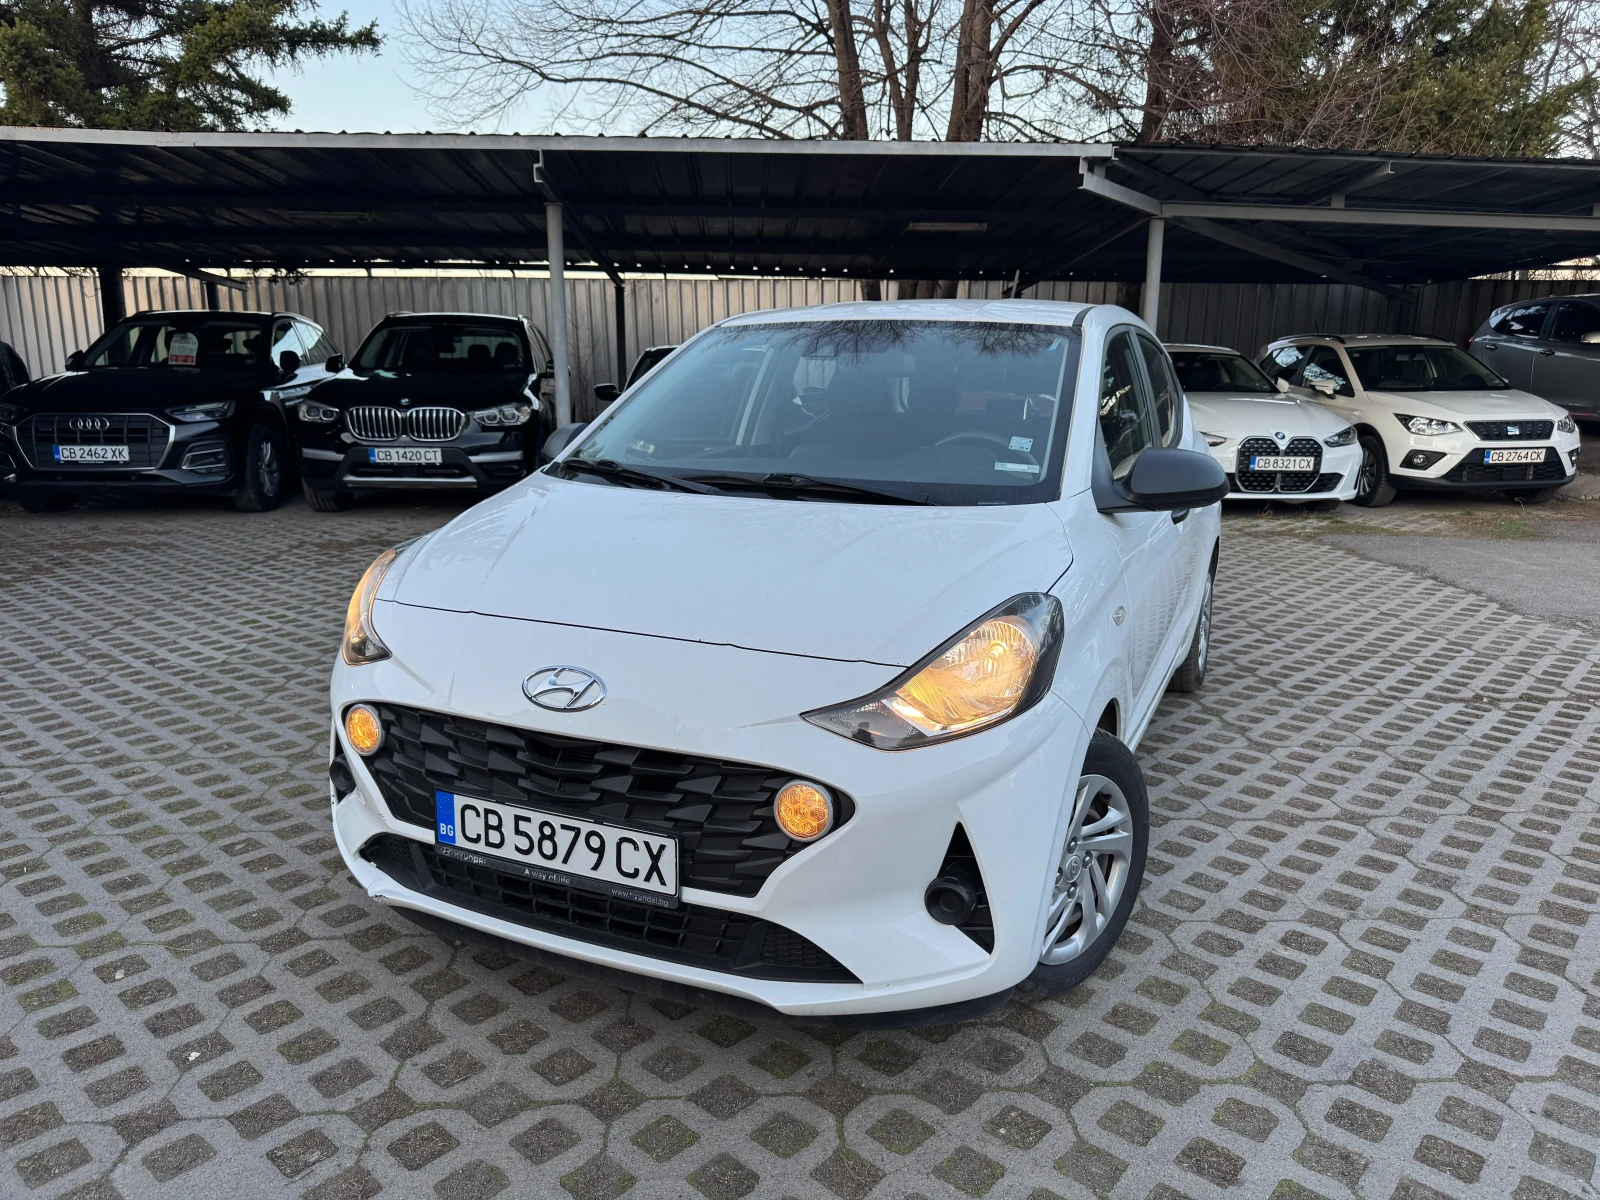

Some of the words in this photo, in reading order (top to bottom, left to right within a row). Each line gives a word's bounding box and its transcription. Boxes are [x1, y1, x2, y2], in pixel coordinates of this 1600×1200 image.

[61, 447, 77, 459] CB
[79, 447, 108, 459] 2462
[110, 447, 127, 459] XK
[377, 450, 393, 461] CB
[395, 450, 422, 461] 1420
[424, 450, 439, 461] CT
[1491, 451, 1504, 462] CB
[1505, 451, 1529, 462] 2764
[1530, 450, 1543, 461] CK
[1256, 458, 1271, 469] CB
[1272, 458, 1296, 469] 8321
[1298, 458, 1312, 469] CX
[440, 822, 455, 837] BG
[460, 803, 506, 850] CB
[513, 813, 606, 872] 5879
[616, 835, 668, 887] CX
[531, 870, 546, 881] way
[548, 873, 556, 881] of
[558, 873, 570, 884] life
